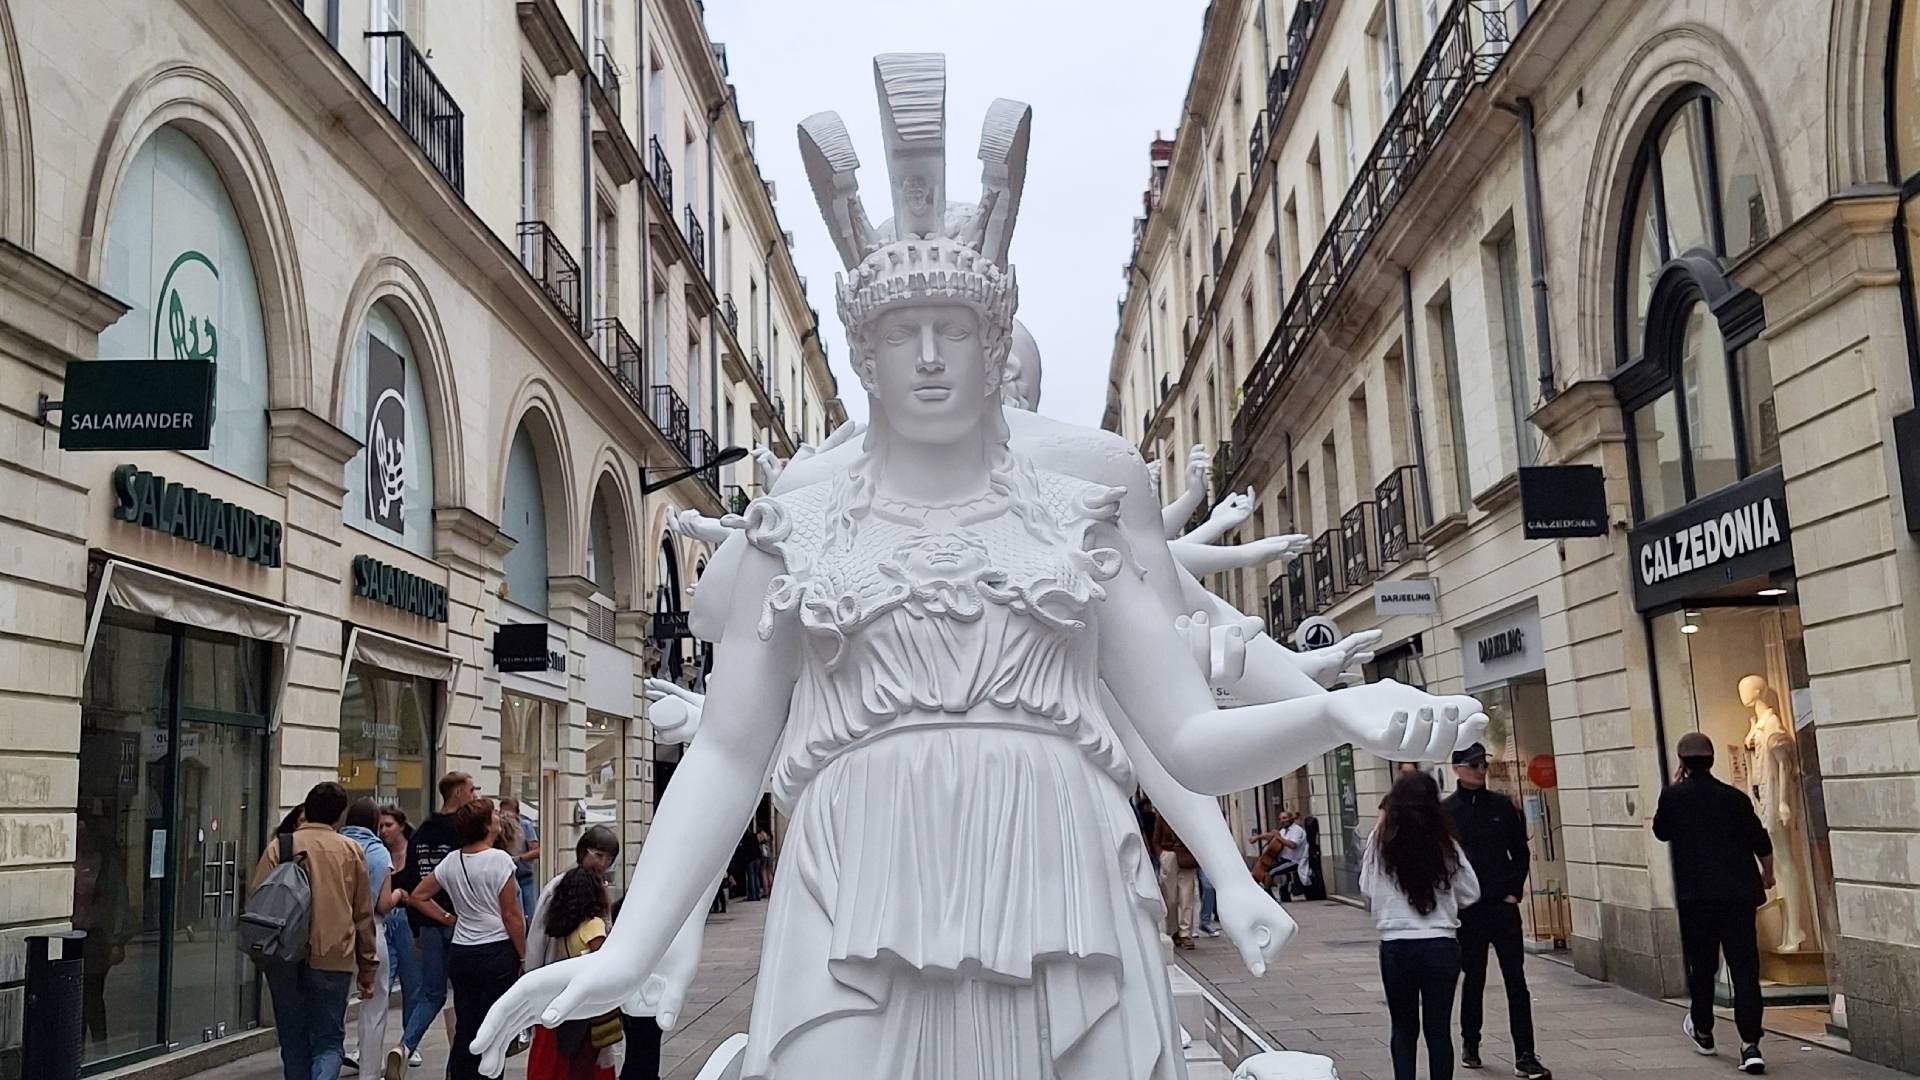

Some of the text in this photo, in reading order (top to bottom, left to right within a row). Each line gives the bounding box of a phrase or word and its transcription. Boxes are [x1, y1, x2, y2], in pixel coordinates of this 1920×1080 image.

[71, 412, 193, 430] SALAMANDER
[114, 464, 283, 568] SALAMANDER
[1527, 520, 1598, 530] CALZEDONIA
[1640, 498, 1781, 586] CALZEDONIA
[352, 554, 449, 623] SALAMANDER
[1381, 593, 1431, 603] DARJEELING
[661, 614, 690, 626] LAN
